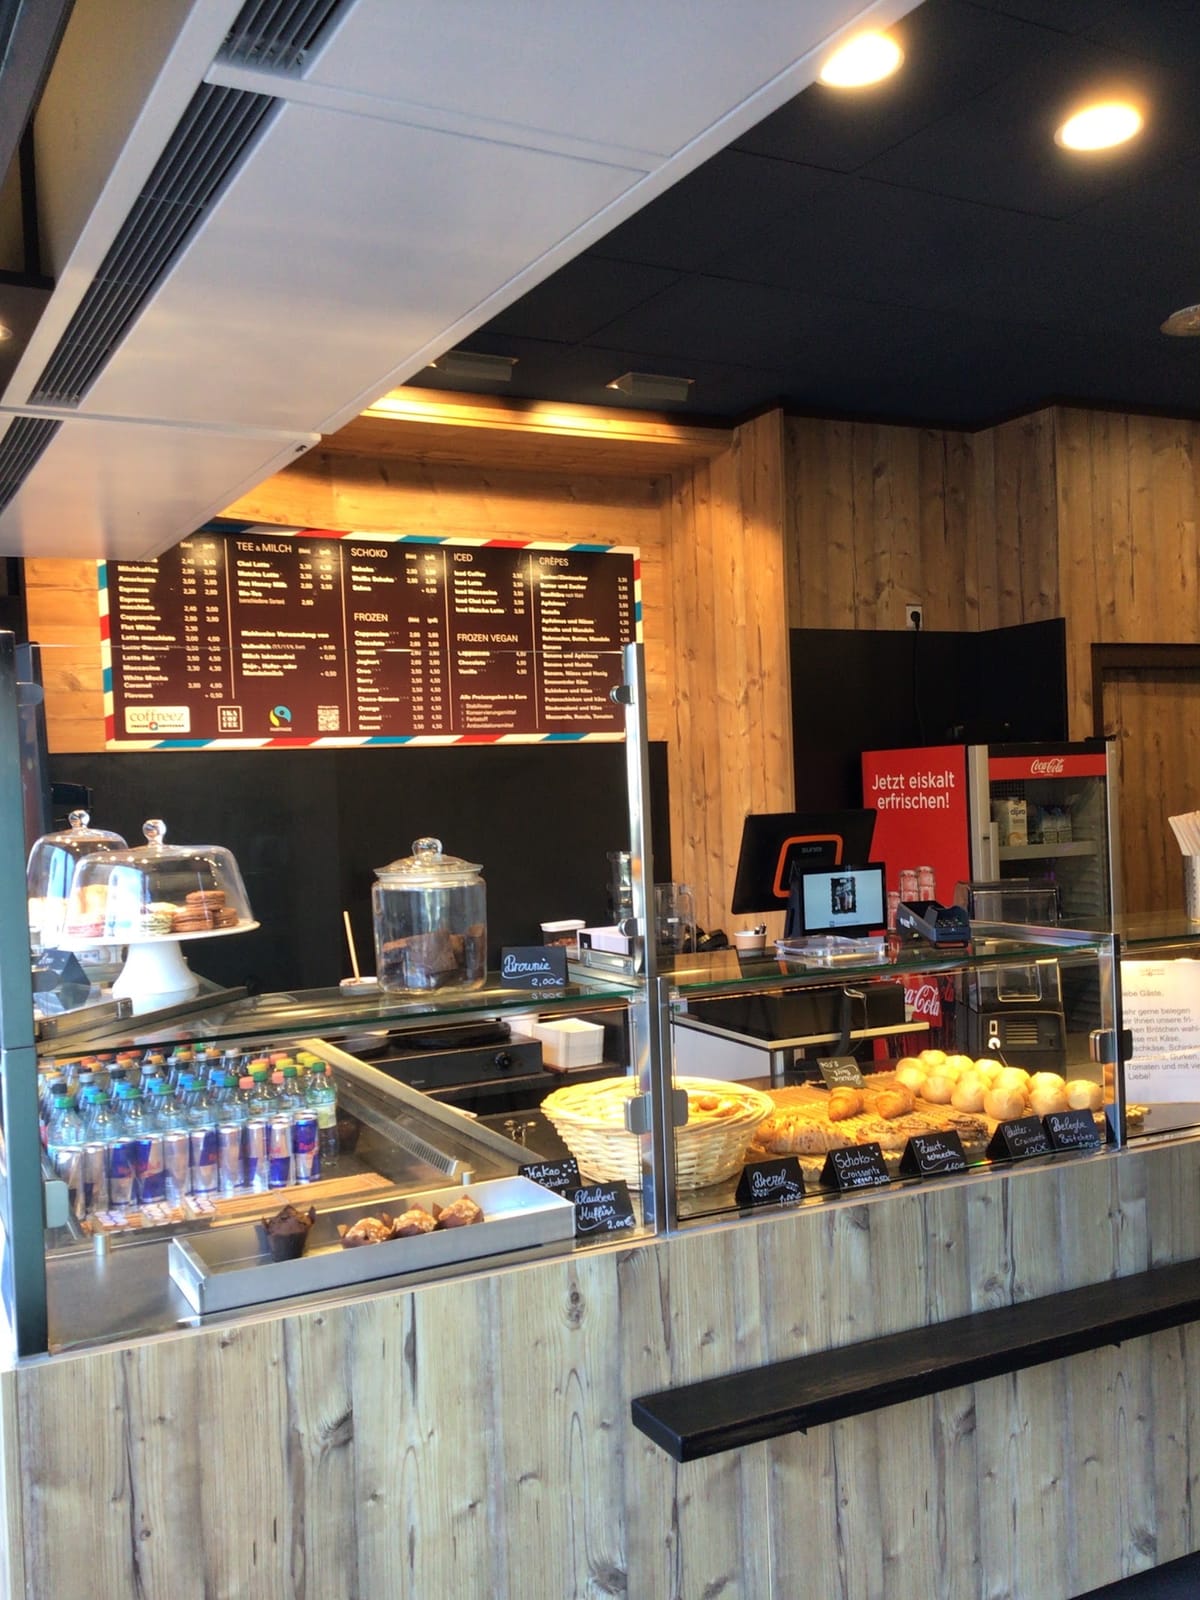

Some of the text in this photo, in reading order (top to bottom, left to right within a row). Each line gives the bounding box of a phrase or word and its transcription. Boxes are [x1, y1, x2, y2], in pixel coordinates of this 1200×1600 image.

[236, 542, 254, 552] TEE
[262, 544, 292, 553] MILCH
[351, 548, 388, 558] SCHOKO
[454, 552, 473, 562] ICED
[354, 612, 388, 622] FROZEN
[276, 631, 316, 639] Verwendung
[456, 634, 518, 642] FROZEN VEGAN
[872, 771, 955, 790] Jetzt eiskalt
[878, 792, 950, 810] erfrischen!
[504, 954, 551, 972] Brownie
[532, 978, 564, 987] 2,00€
[1160, 1008, 1190, 1018] belegen
[1128, 1063, 1160, 1071] Tomaten
[835, 1152, 874, 1168] Schoko-
[854, 1176, 873, 1184] vegan
